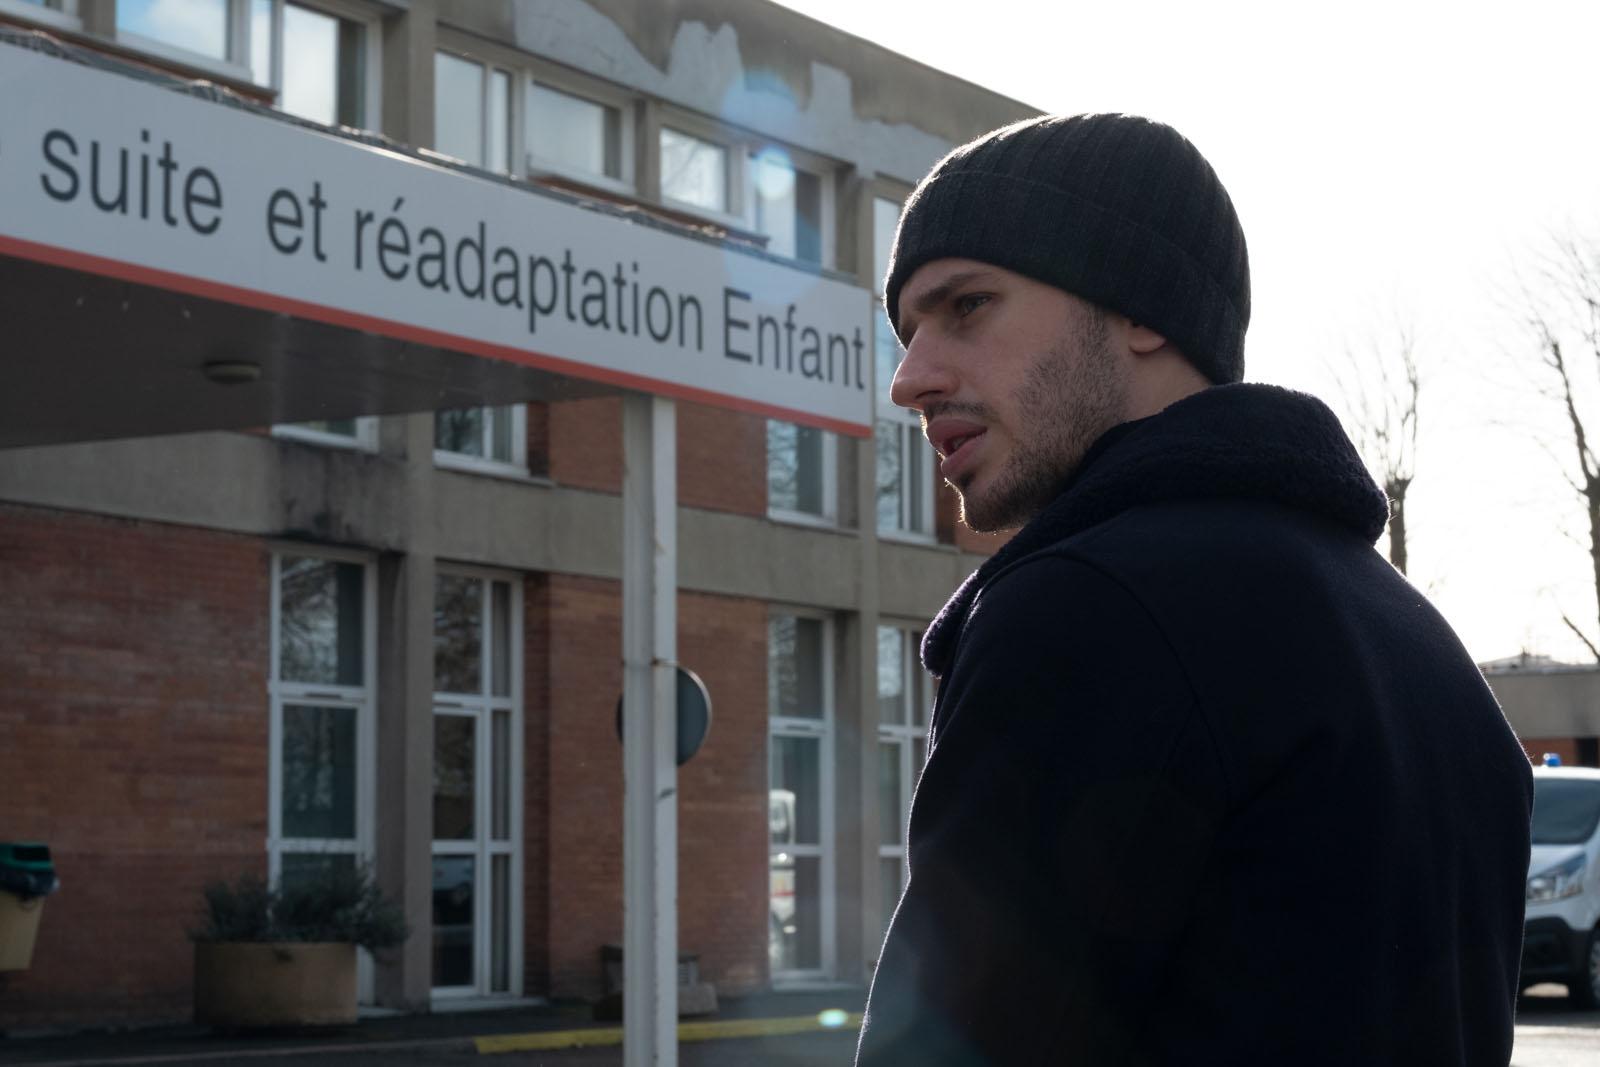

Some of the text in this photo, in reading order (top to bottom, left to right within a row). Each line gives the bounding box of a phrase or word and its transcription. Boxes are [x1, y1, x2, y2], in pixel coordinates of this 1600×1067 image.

[40, 128, 865, 391] suite et réadaptation Enfant
